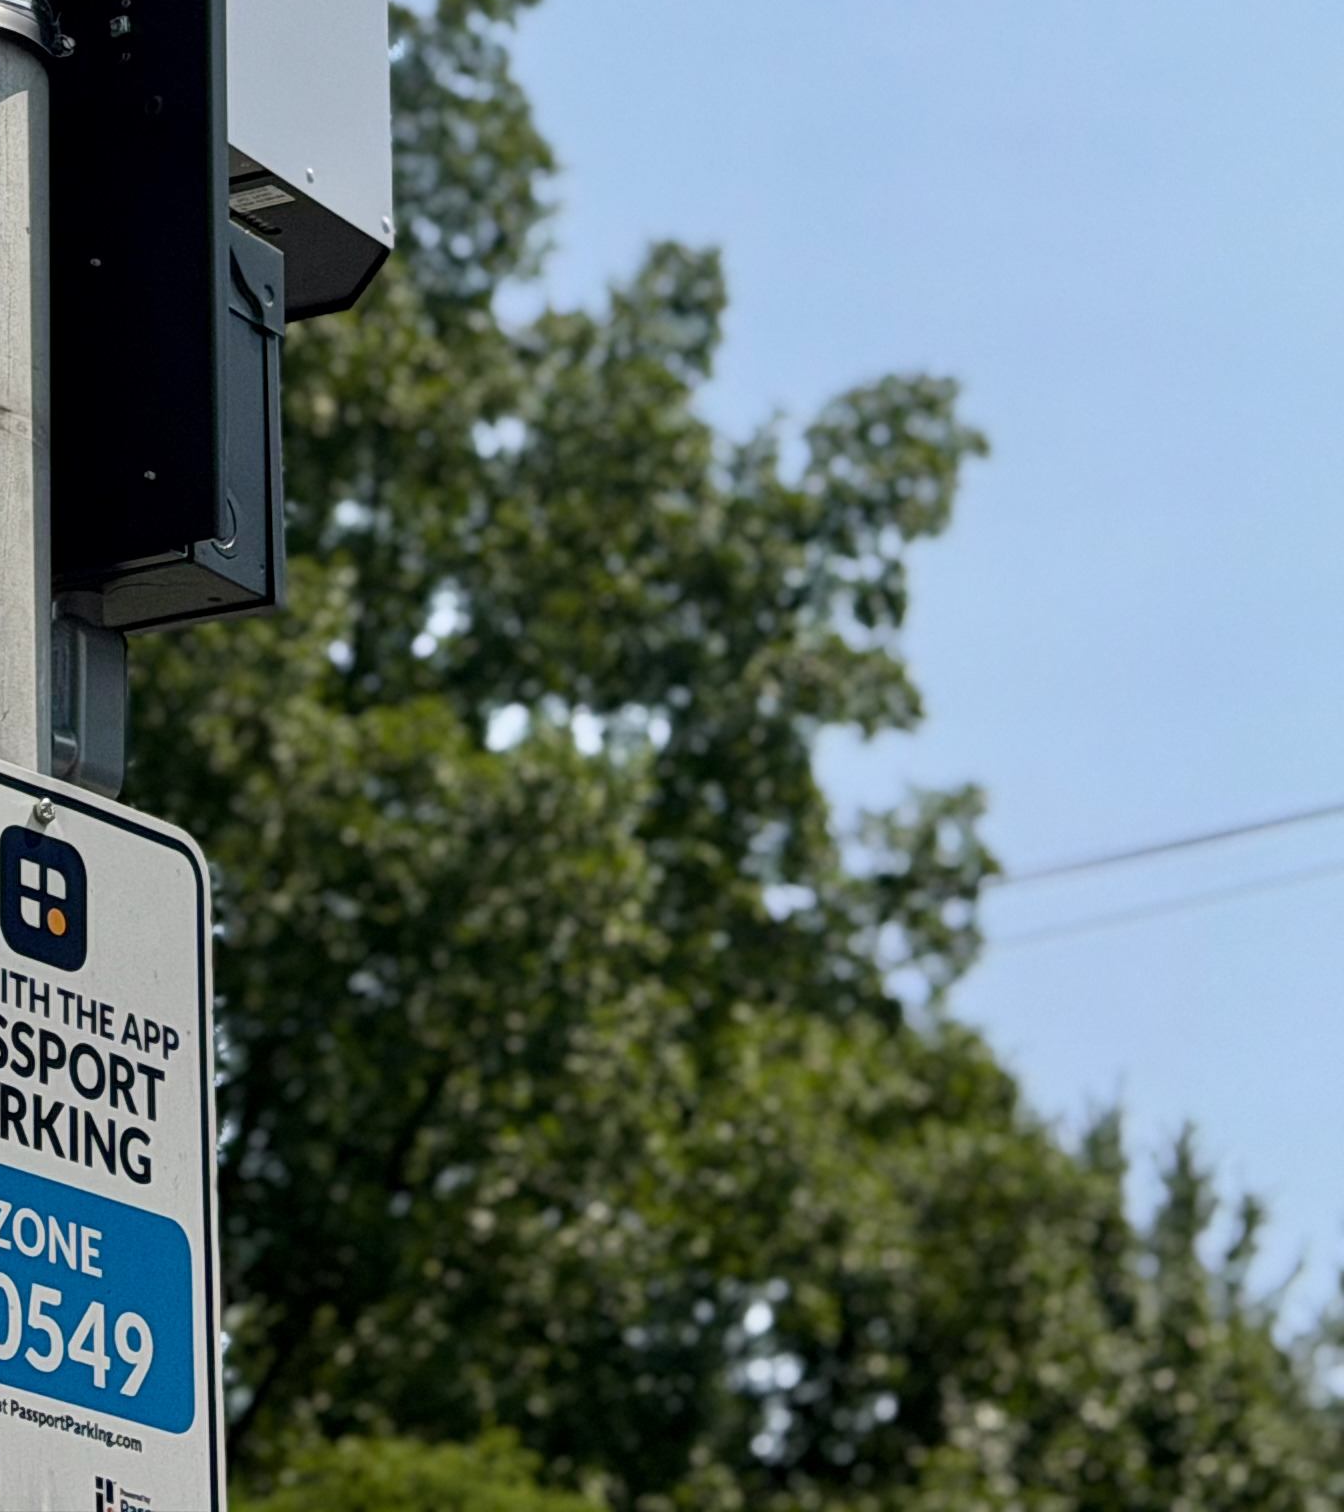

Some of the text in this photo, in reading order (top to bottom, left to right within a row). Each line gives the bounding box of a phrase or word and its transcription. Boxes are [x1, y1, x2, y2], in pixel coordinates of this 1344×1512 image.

[57, 988, 115, 1041] THE
[120, 1013, 180, 1060] APP
[10, 1399, 143, 1453] PassportParking.com
